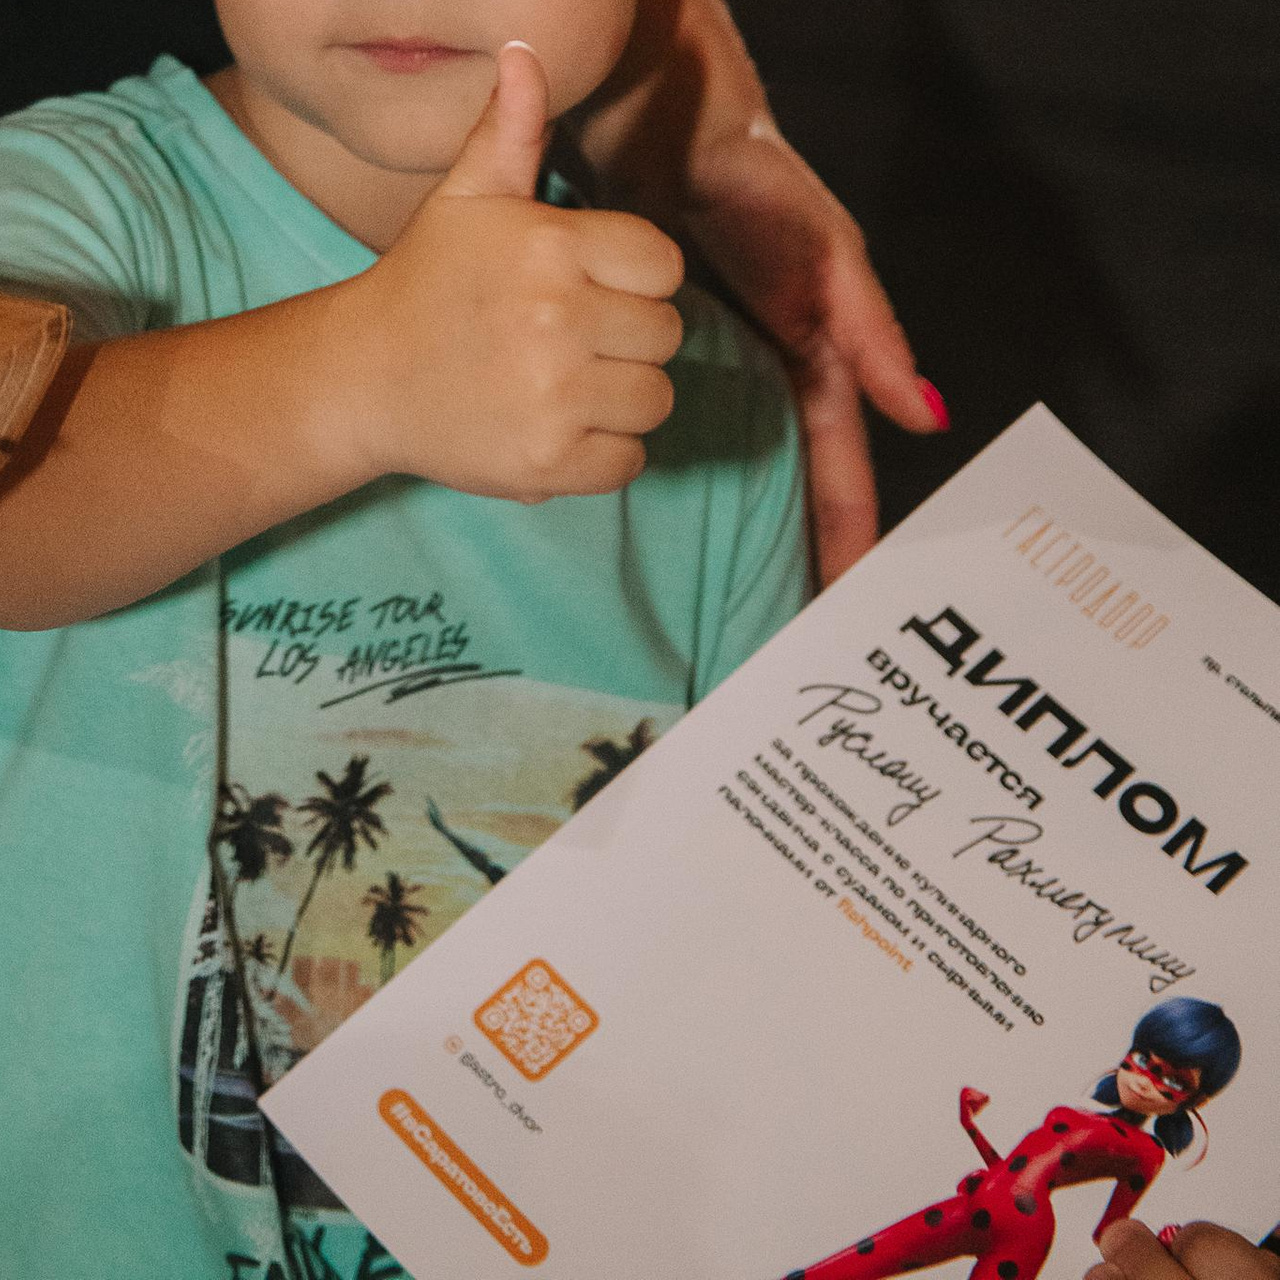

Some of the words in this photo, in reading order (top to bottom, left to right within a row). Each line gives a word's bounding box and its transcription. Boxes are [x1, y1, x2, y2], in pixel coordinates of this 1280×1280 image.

[256, 639, 320, 684] LOS
[336, 622, 469, 683] ANGELES
[370, 591, 446, 630] TOUR
[1003, 505, 1170, 650] ГАСТРОДВОР
[866, 647, 1045, 811] вручается
[899, 606, 1251, 896] ДИПЛОМ
[718, 785, 813, 879] палочками
[814, 878, 837, 899] от
[754, 753, 880, 877] мастер-класса
[882, 875, 906, 899] по
[906, 899, 1045, 1027] приготовлению
[773, 738, 793, 761] за
[794, 760, 911, 870] прохождение
[911, 871, 1027, 977] кулинарного
[822, 852, 835, 866] с
[911, 934, 926, 952] и
[927, 951, 1015, 1032] сырными
